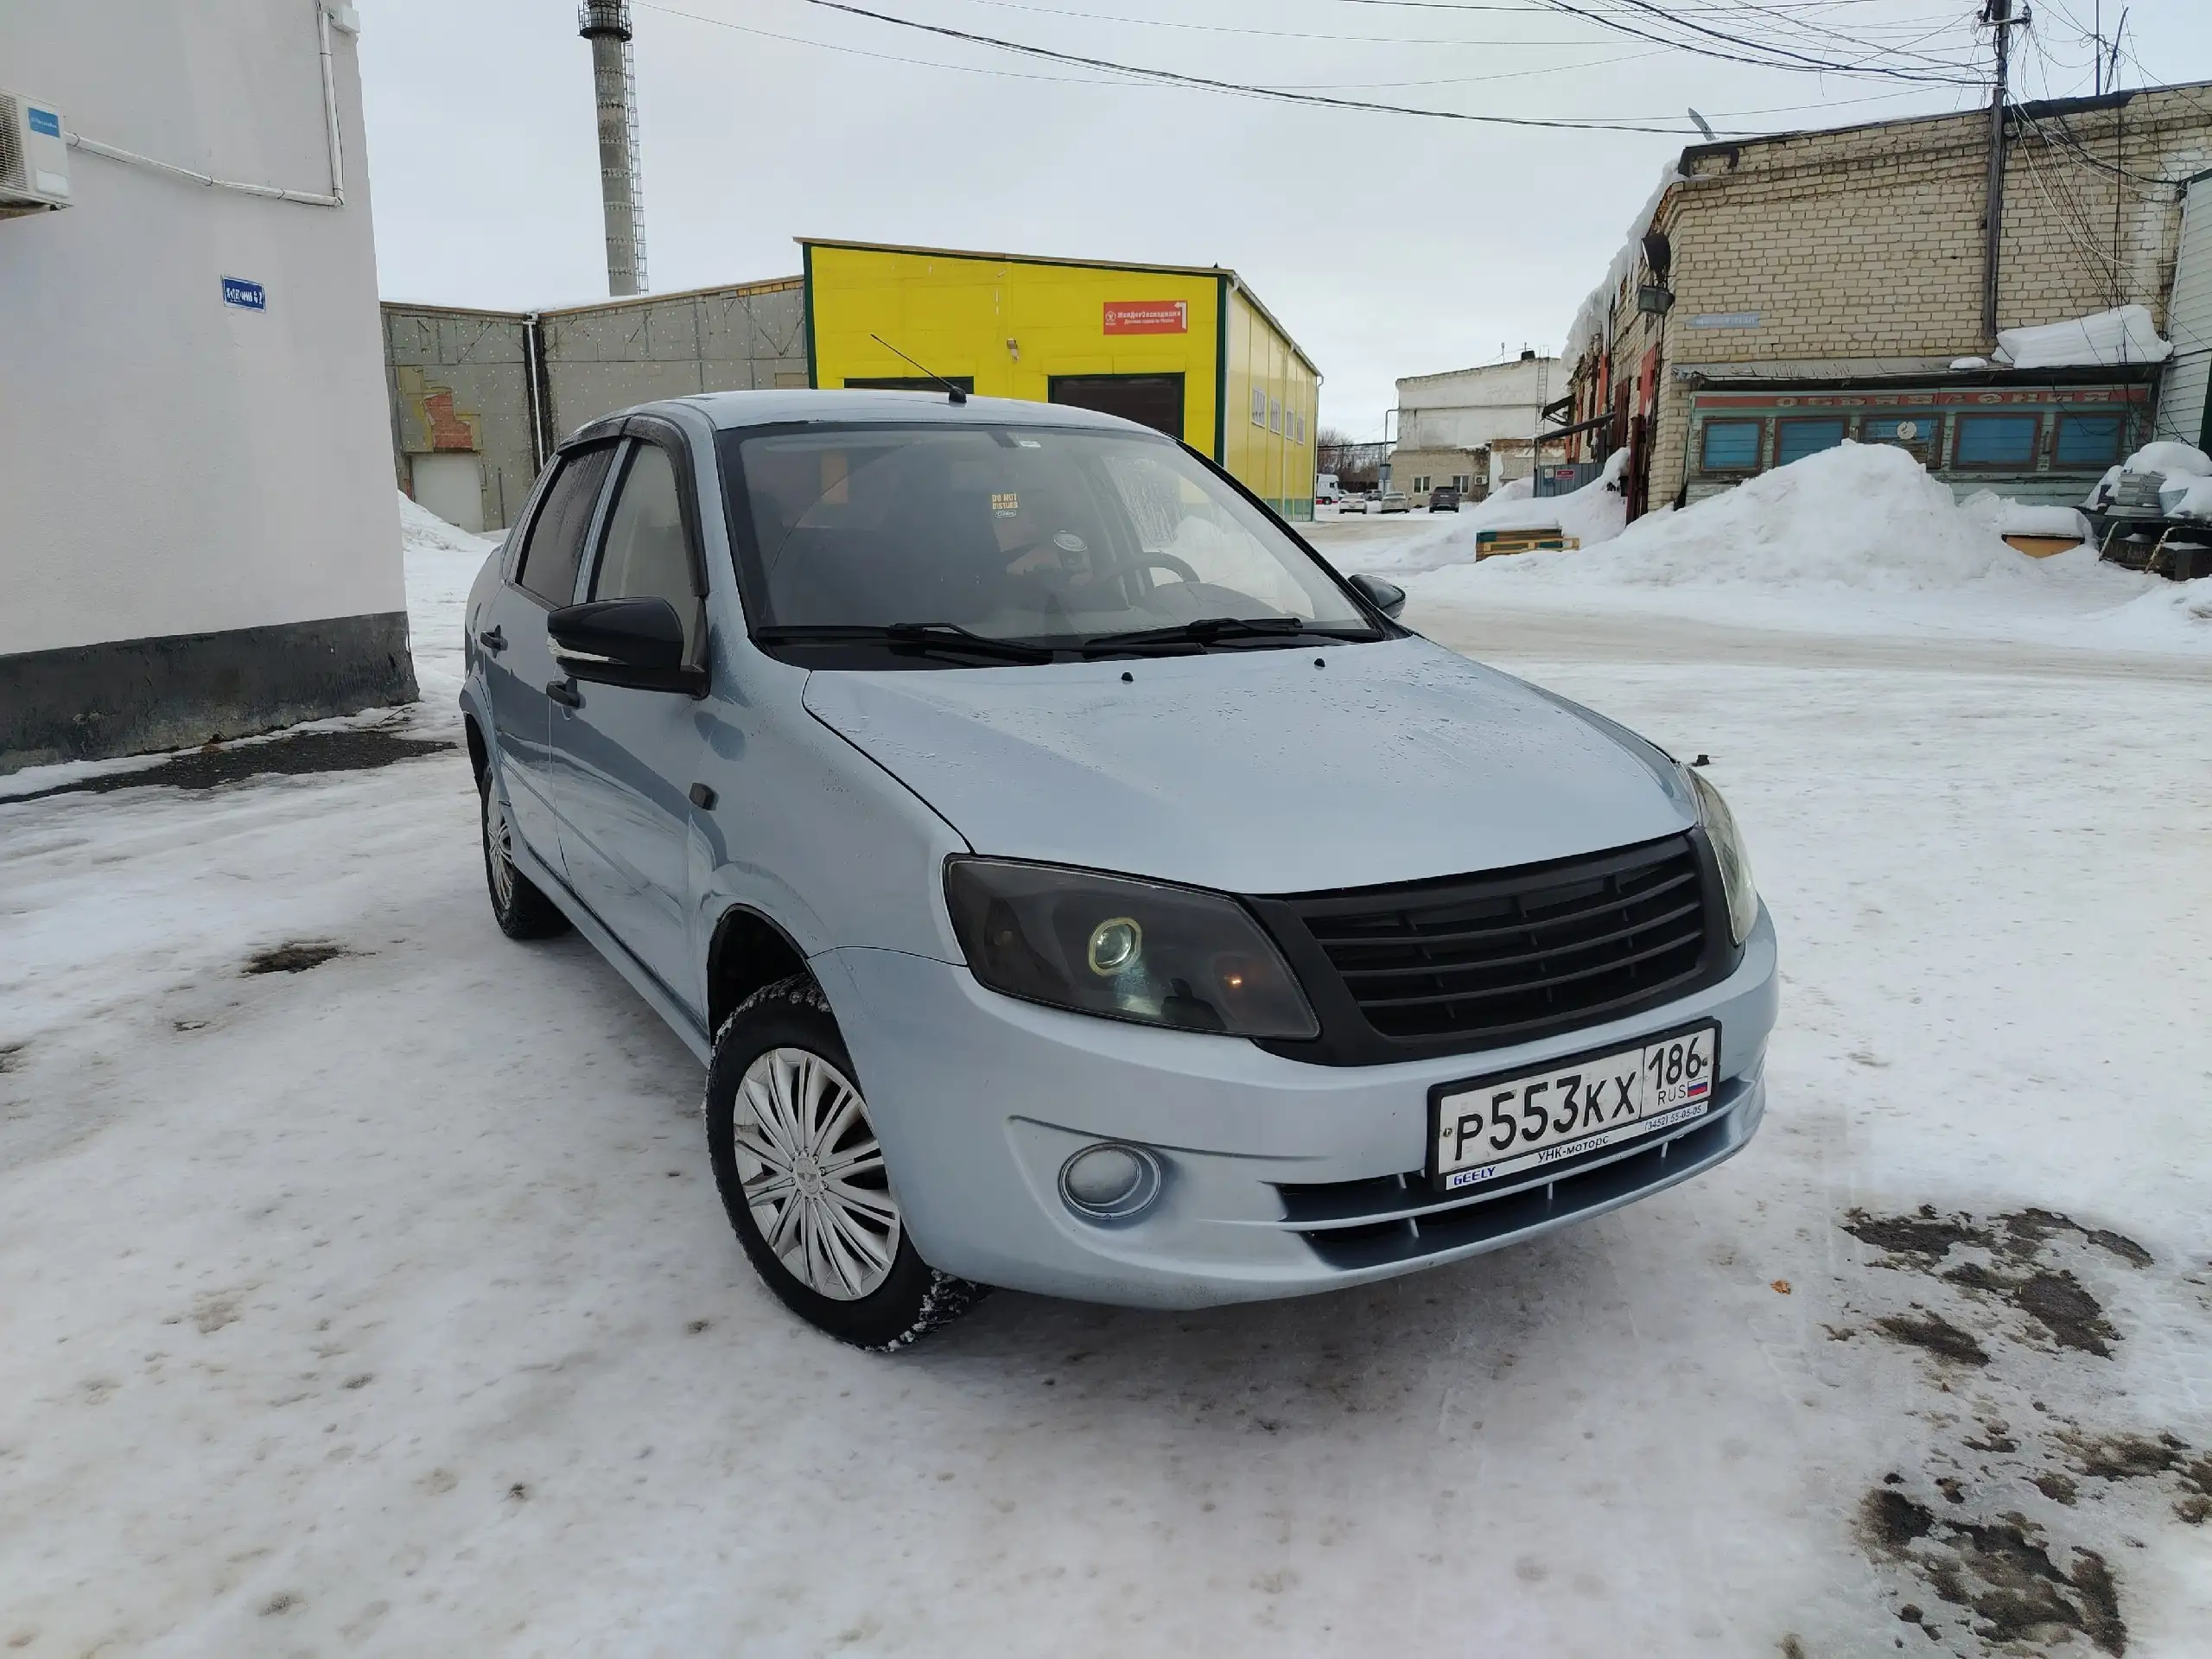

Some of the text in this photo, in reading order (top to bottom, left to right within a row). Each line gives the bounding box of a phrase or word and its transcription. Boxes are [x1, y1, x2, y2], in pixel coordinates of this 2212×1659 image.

[992, 500, 1018, 509] DISTURB
[1649, 1036, 1701, 1090] 186
[1657, 1084, 1687, 1106] RUS
[1644, 1105, 1702, 1132] (3452) 55-05-05
[1453, 1166, 1497, 1185] GEELY
